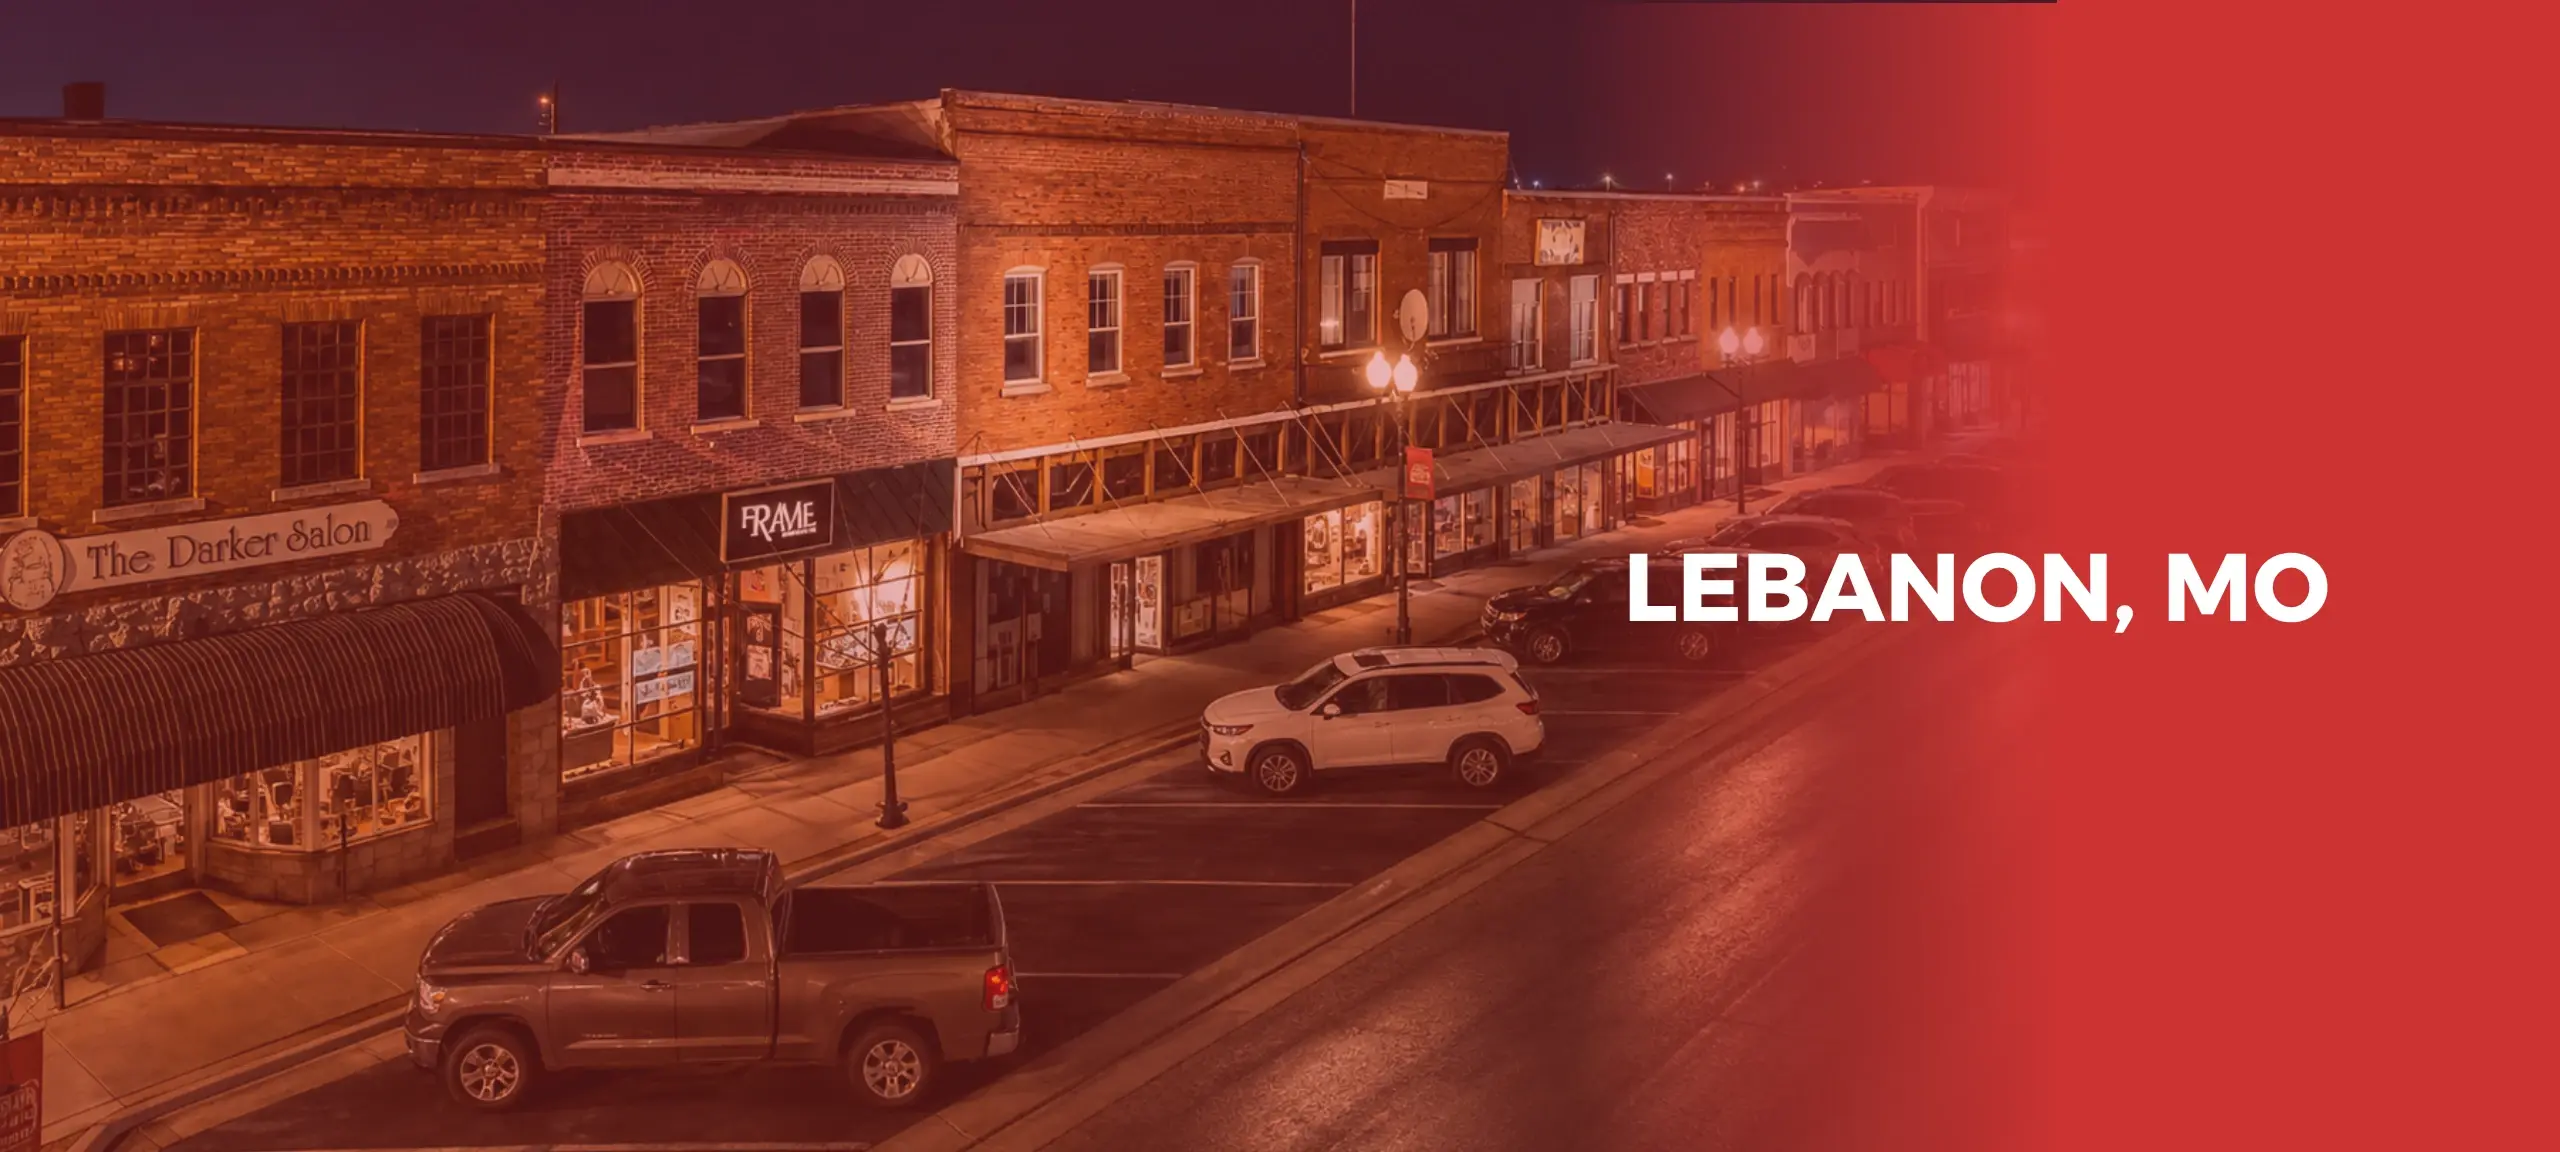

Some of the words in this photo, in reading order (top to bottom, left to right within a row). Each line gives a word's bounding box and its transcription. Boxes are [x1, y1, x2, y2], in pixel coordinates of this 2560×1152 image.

[86, 540, 155, 580] The
[166, 525, 279, 569] Darker
[286, 512, 372, 552] Salon
[741, 501, 817, 542] FRAME
